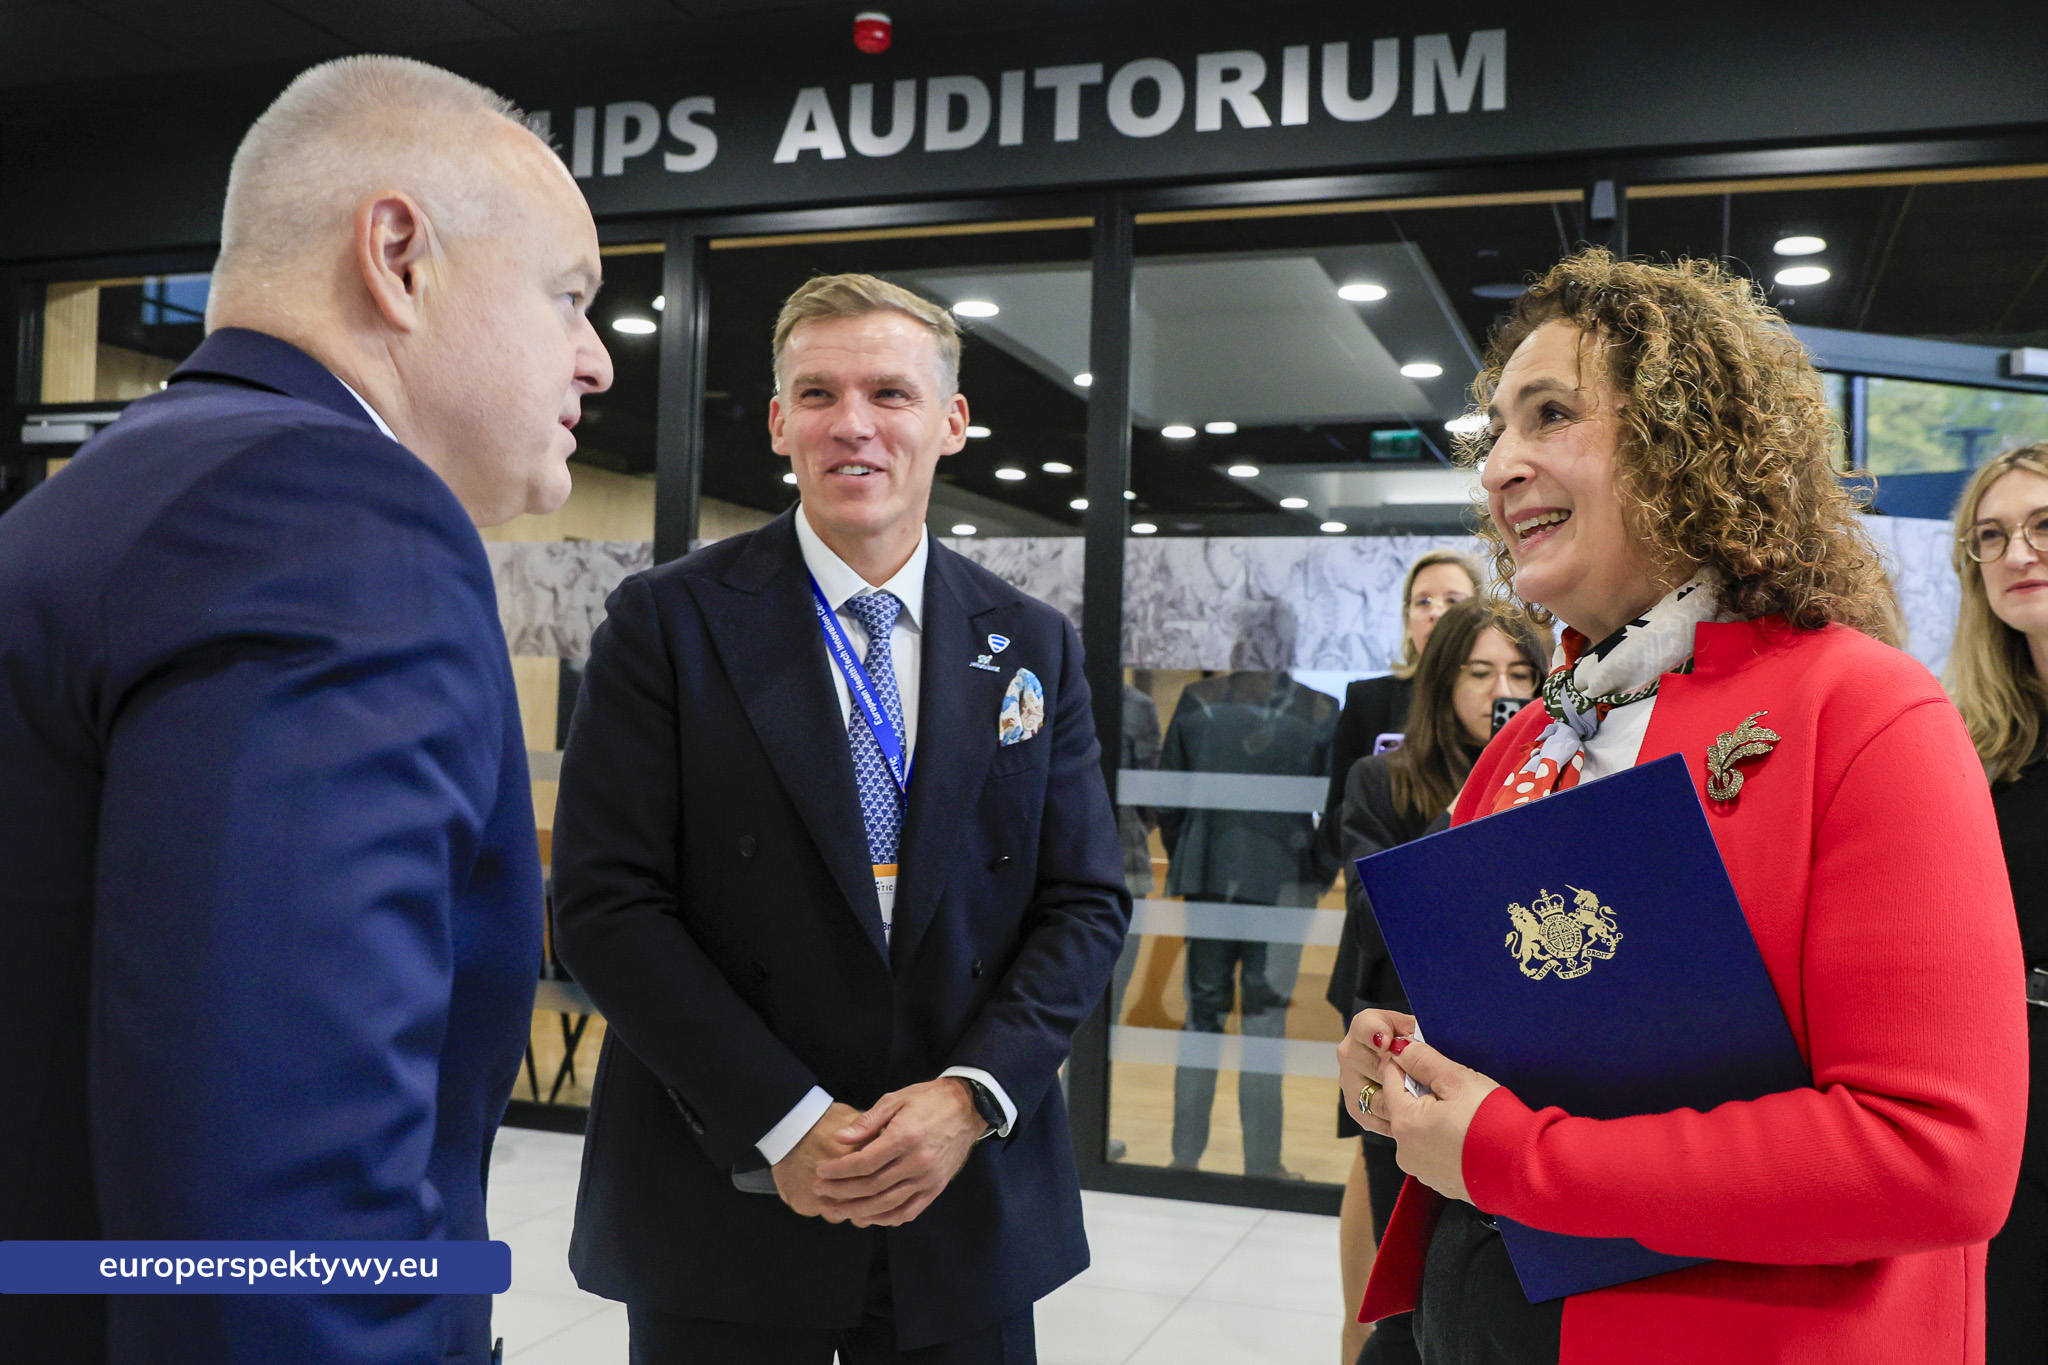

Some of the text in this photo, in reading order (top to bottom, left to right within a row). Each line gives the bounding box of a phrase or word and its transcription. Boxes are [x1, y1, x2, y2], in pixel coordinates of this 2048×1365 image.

[773, 27, 1507, 164] AUDITORIUM
[821, 614, 845, 652] Innovation
[840, 649, 866, 691] HealthTech
[860, 690, 884, 726] European
[1538, 962, 1552, 978] DIEU
[1573, 966, 1589, 977] MON
[1586, 949, 1609, 959] DROIT
